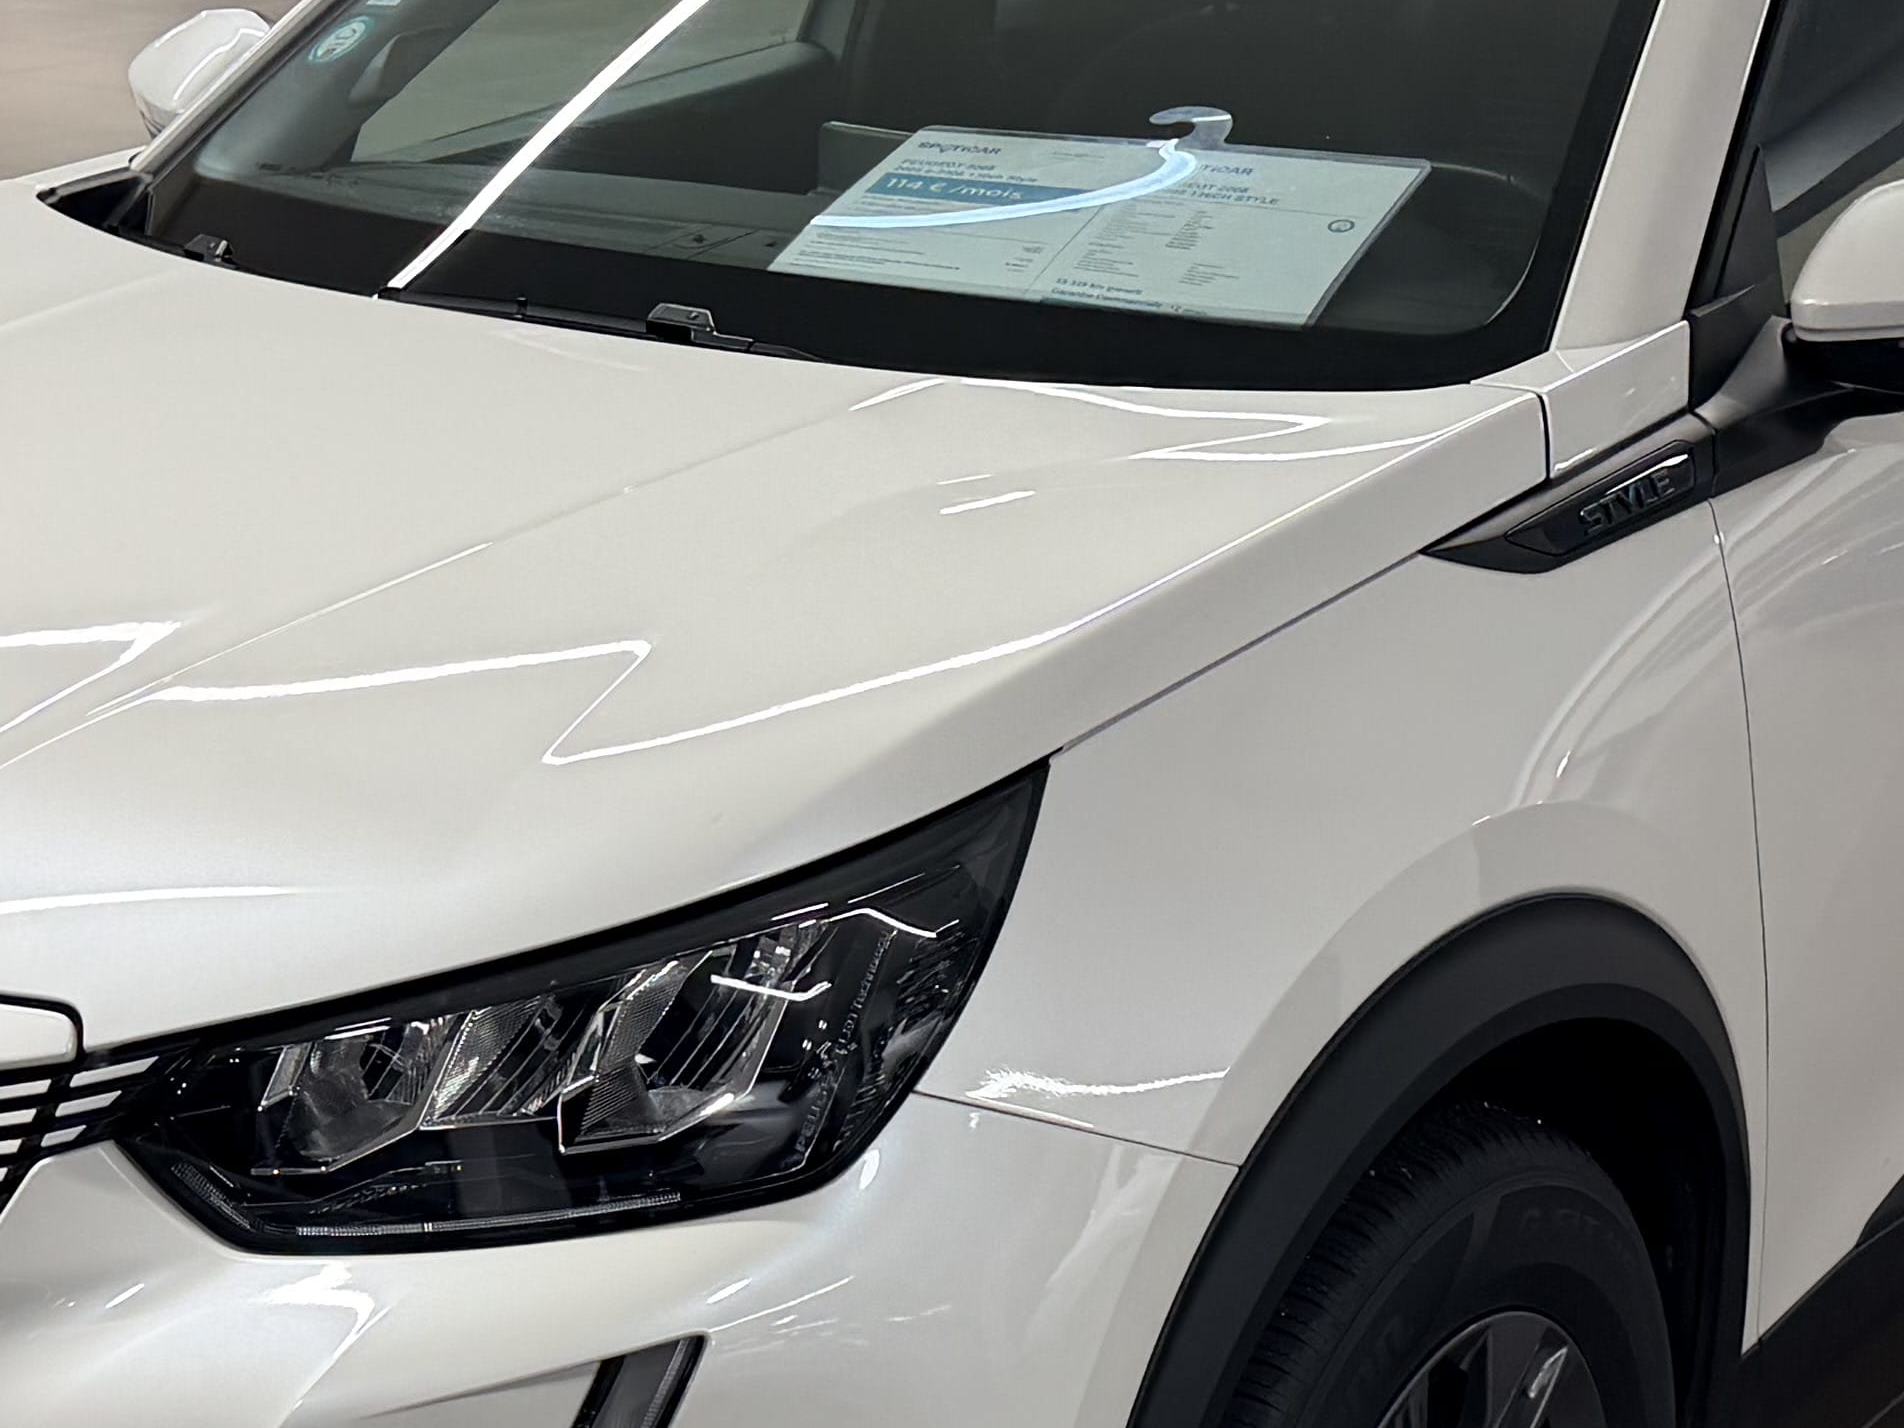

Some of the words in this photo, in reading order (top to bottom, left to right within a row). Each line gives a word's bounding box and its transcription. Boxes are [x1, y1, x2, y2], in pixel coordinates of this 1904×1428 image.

[886, 179, 923, 190] 114
[929, 181, 947, 193] €
[948, 184, 1024, 200] /mois
[1579, 468, 1676, 536] STYLE
